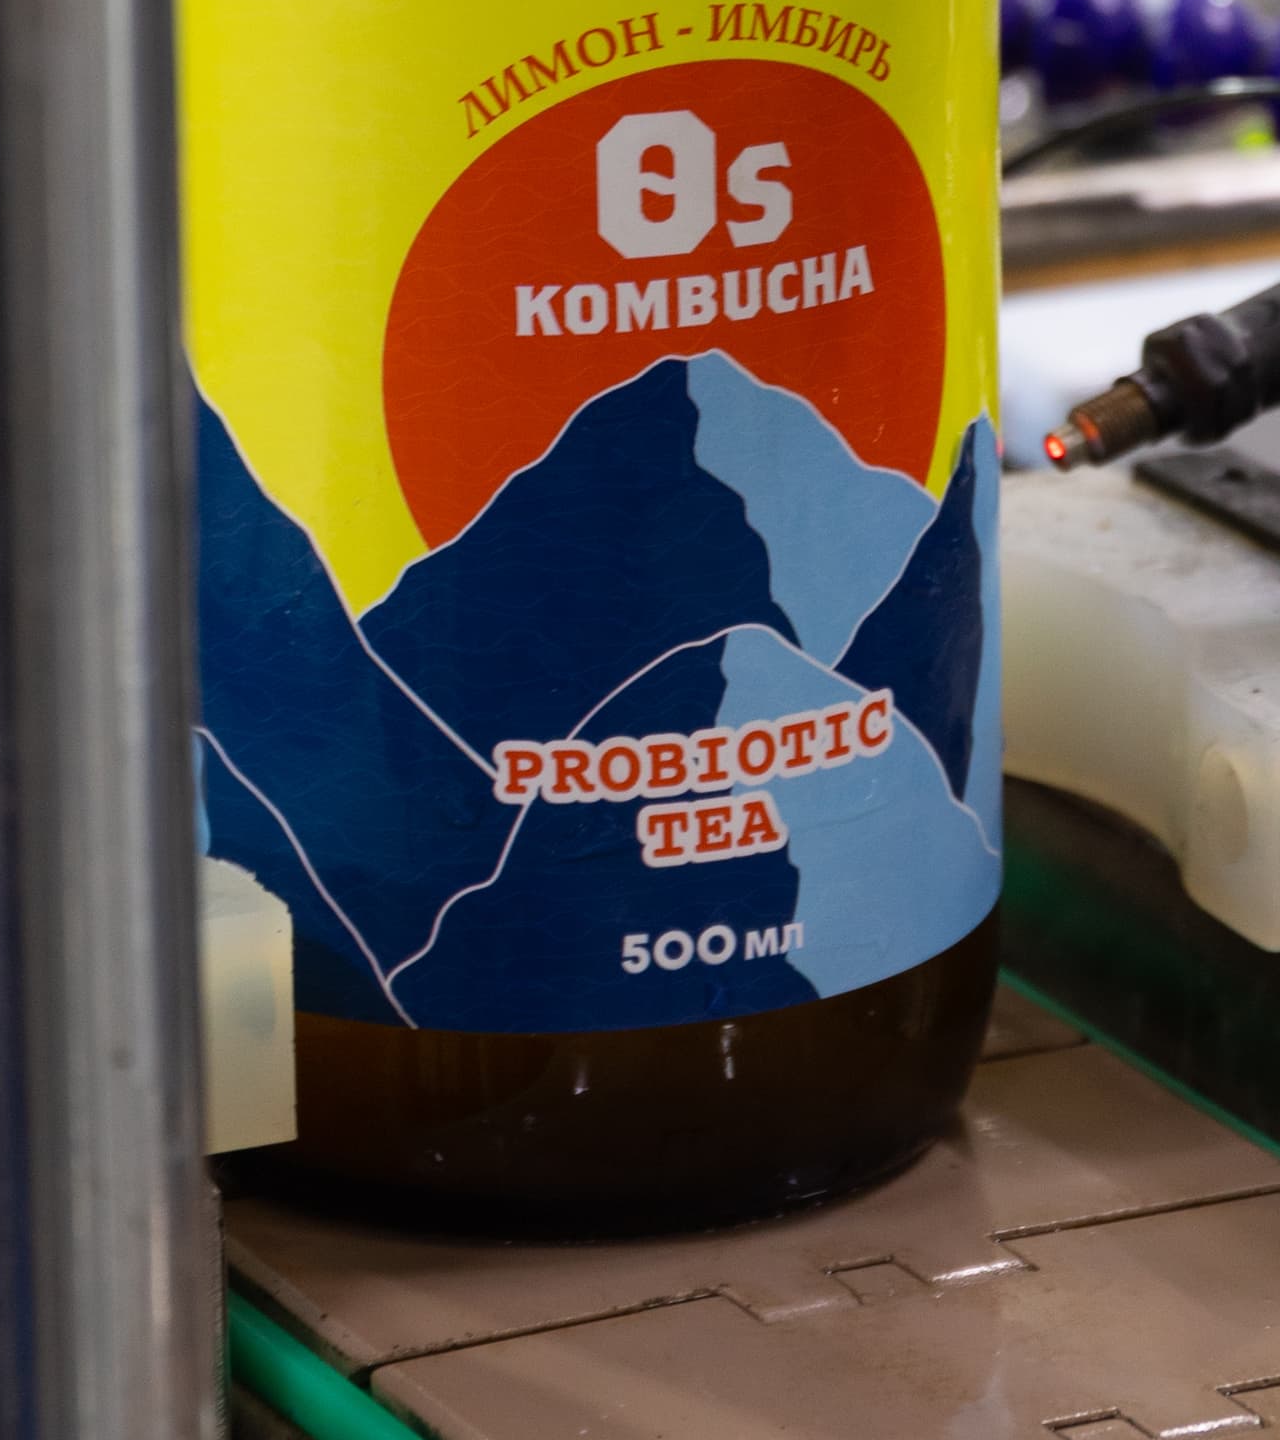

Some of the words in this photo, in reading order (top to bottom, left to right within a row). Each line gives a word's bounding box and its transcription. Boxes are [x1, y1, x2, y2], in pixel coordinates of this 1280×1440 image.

[458, 12, 664, 138] ЛИМОН
[707, 2, 891, 82] ИМБИРЬ
[515, 245, 874, 337] KOMBUCHA
[503, 698, 887, 794] PROBIOTIC
[647, 800, 779, 858] TEA
[621, 925, 736, 973] 500
